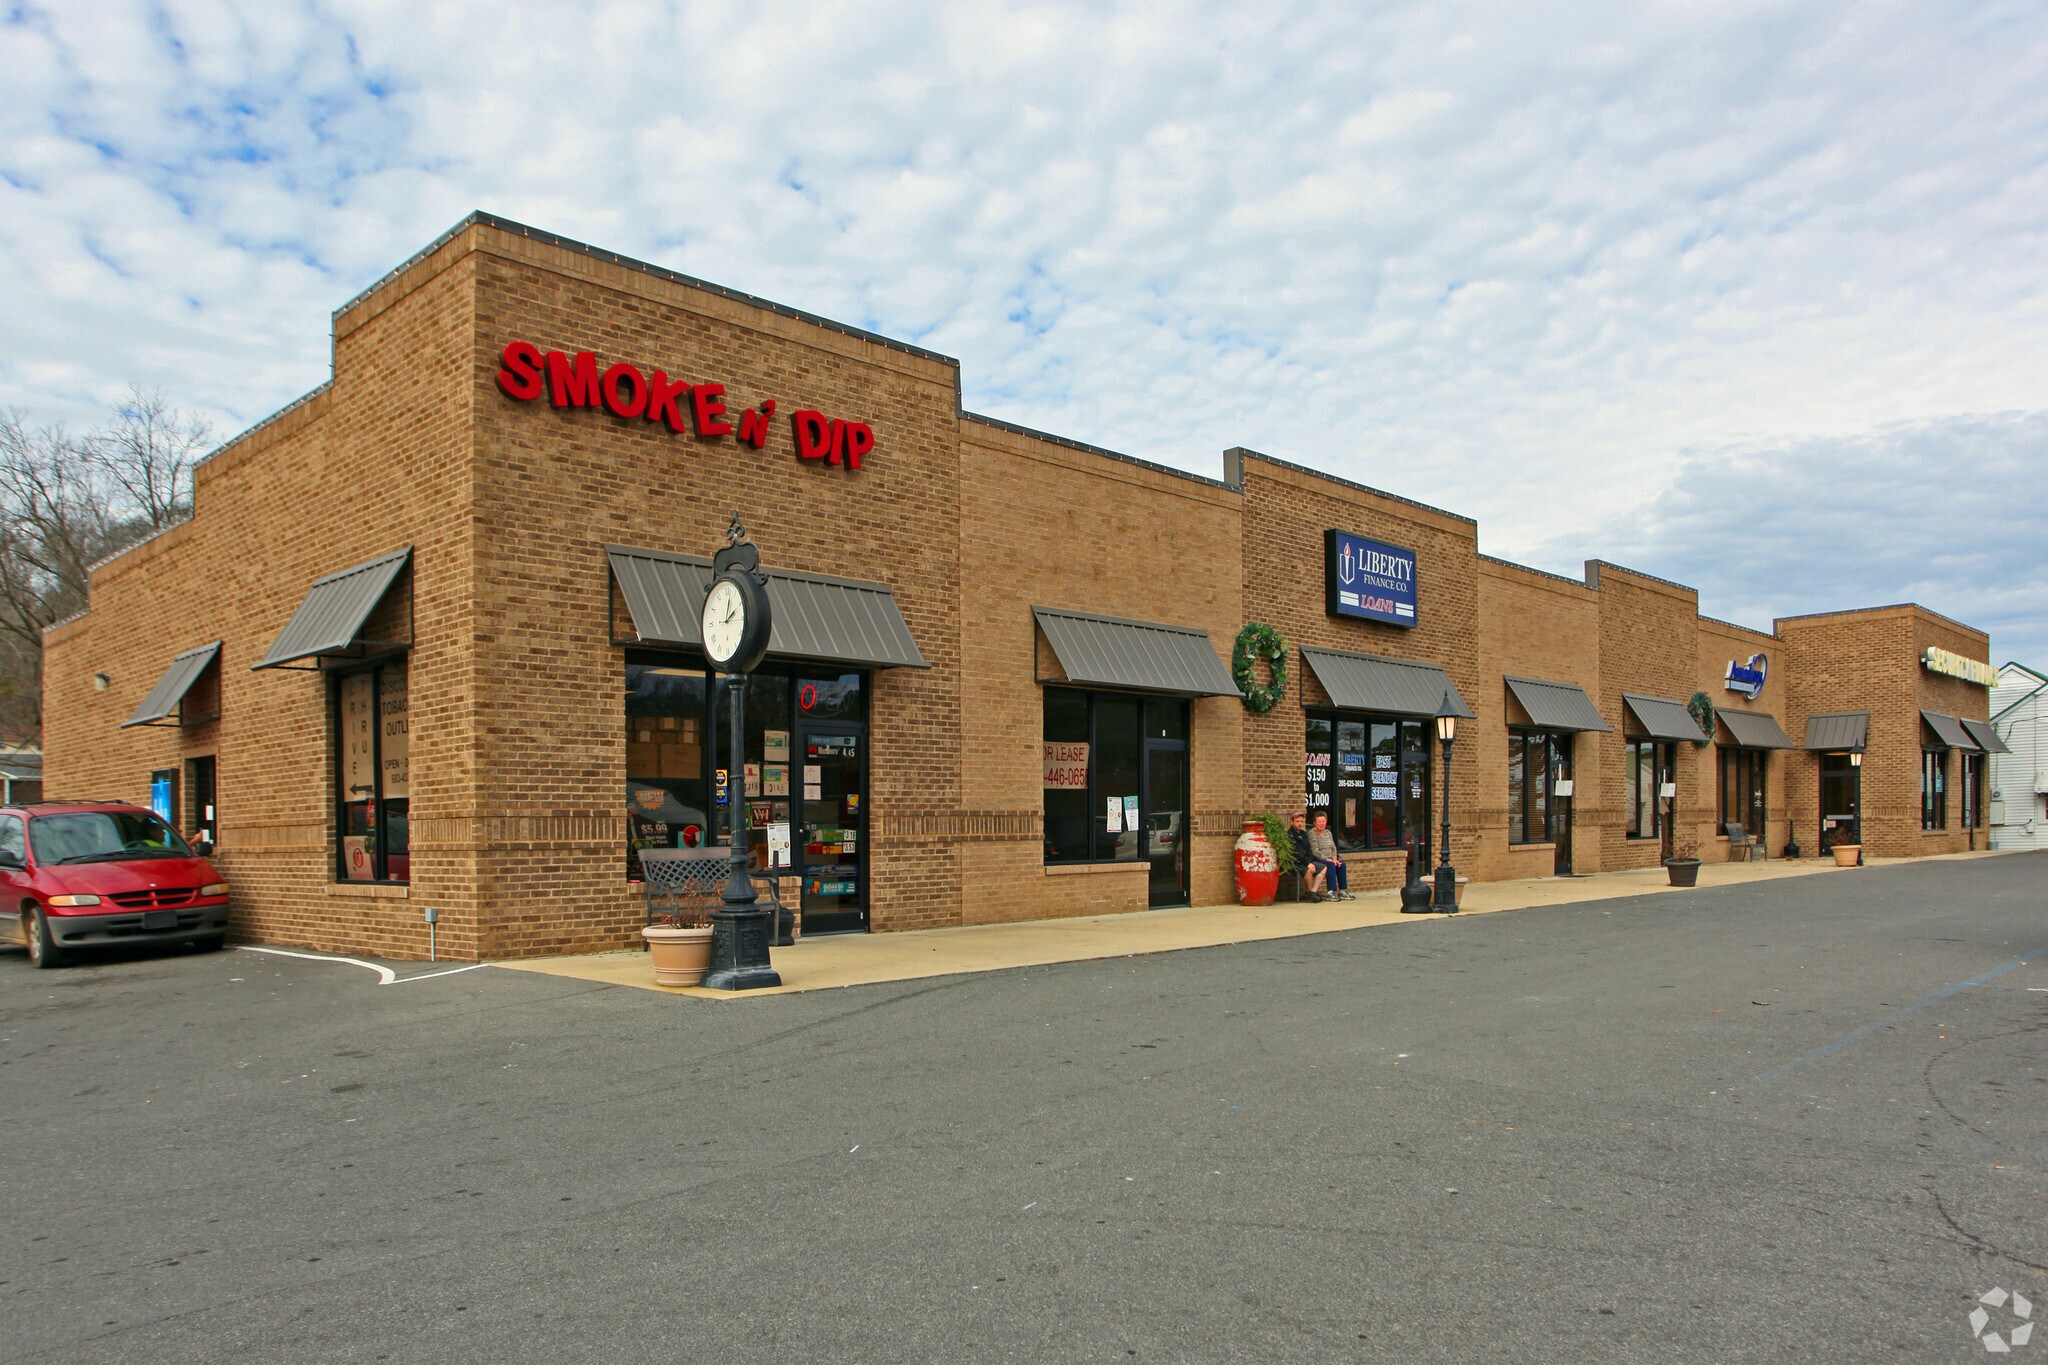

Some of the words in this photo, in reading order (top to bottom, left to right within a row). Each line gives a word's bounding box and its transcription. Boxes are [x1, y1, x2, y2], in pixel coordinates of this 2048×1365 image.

[497, 341, 731, 439] SMOKE
[790, 409, 875, 470] DIP
[1358, 548, 1413, 581] LIBERTY
[1363, 574, 1395, 590] FINANCE
[1395, 581, 1409, 593] CO.
[1360, 594, 1394, 614] LOANS
[380, 679, 408, 696] DISCO
[1055, 746, 1085, 762] LEASE
[1305, 752, 1331, 767] LOANS
[1341, 752, 1366, 766] LIBERTY
[1375, 754, 1392, 769] FAST
[1307, 767, 1327, 782] $150
[1313, 782, 1320, 792] to
[1371, 786, 1397, 800] SERVICE
[1305, 792, 1330, 808] $1,000
[640, 822, 668, 836] $5.99
